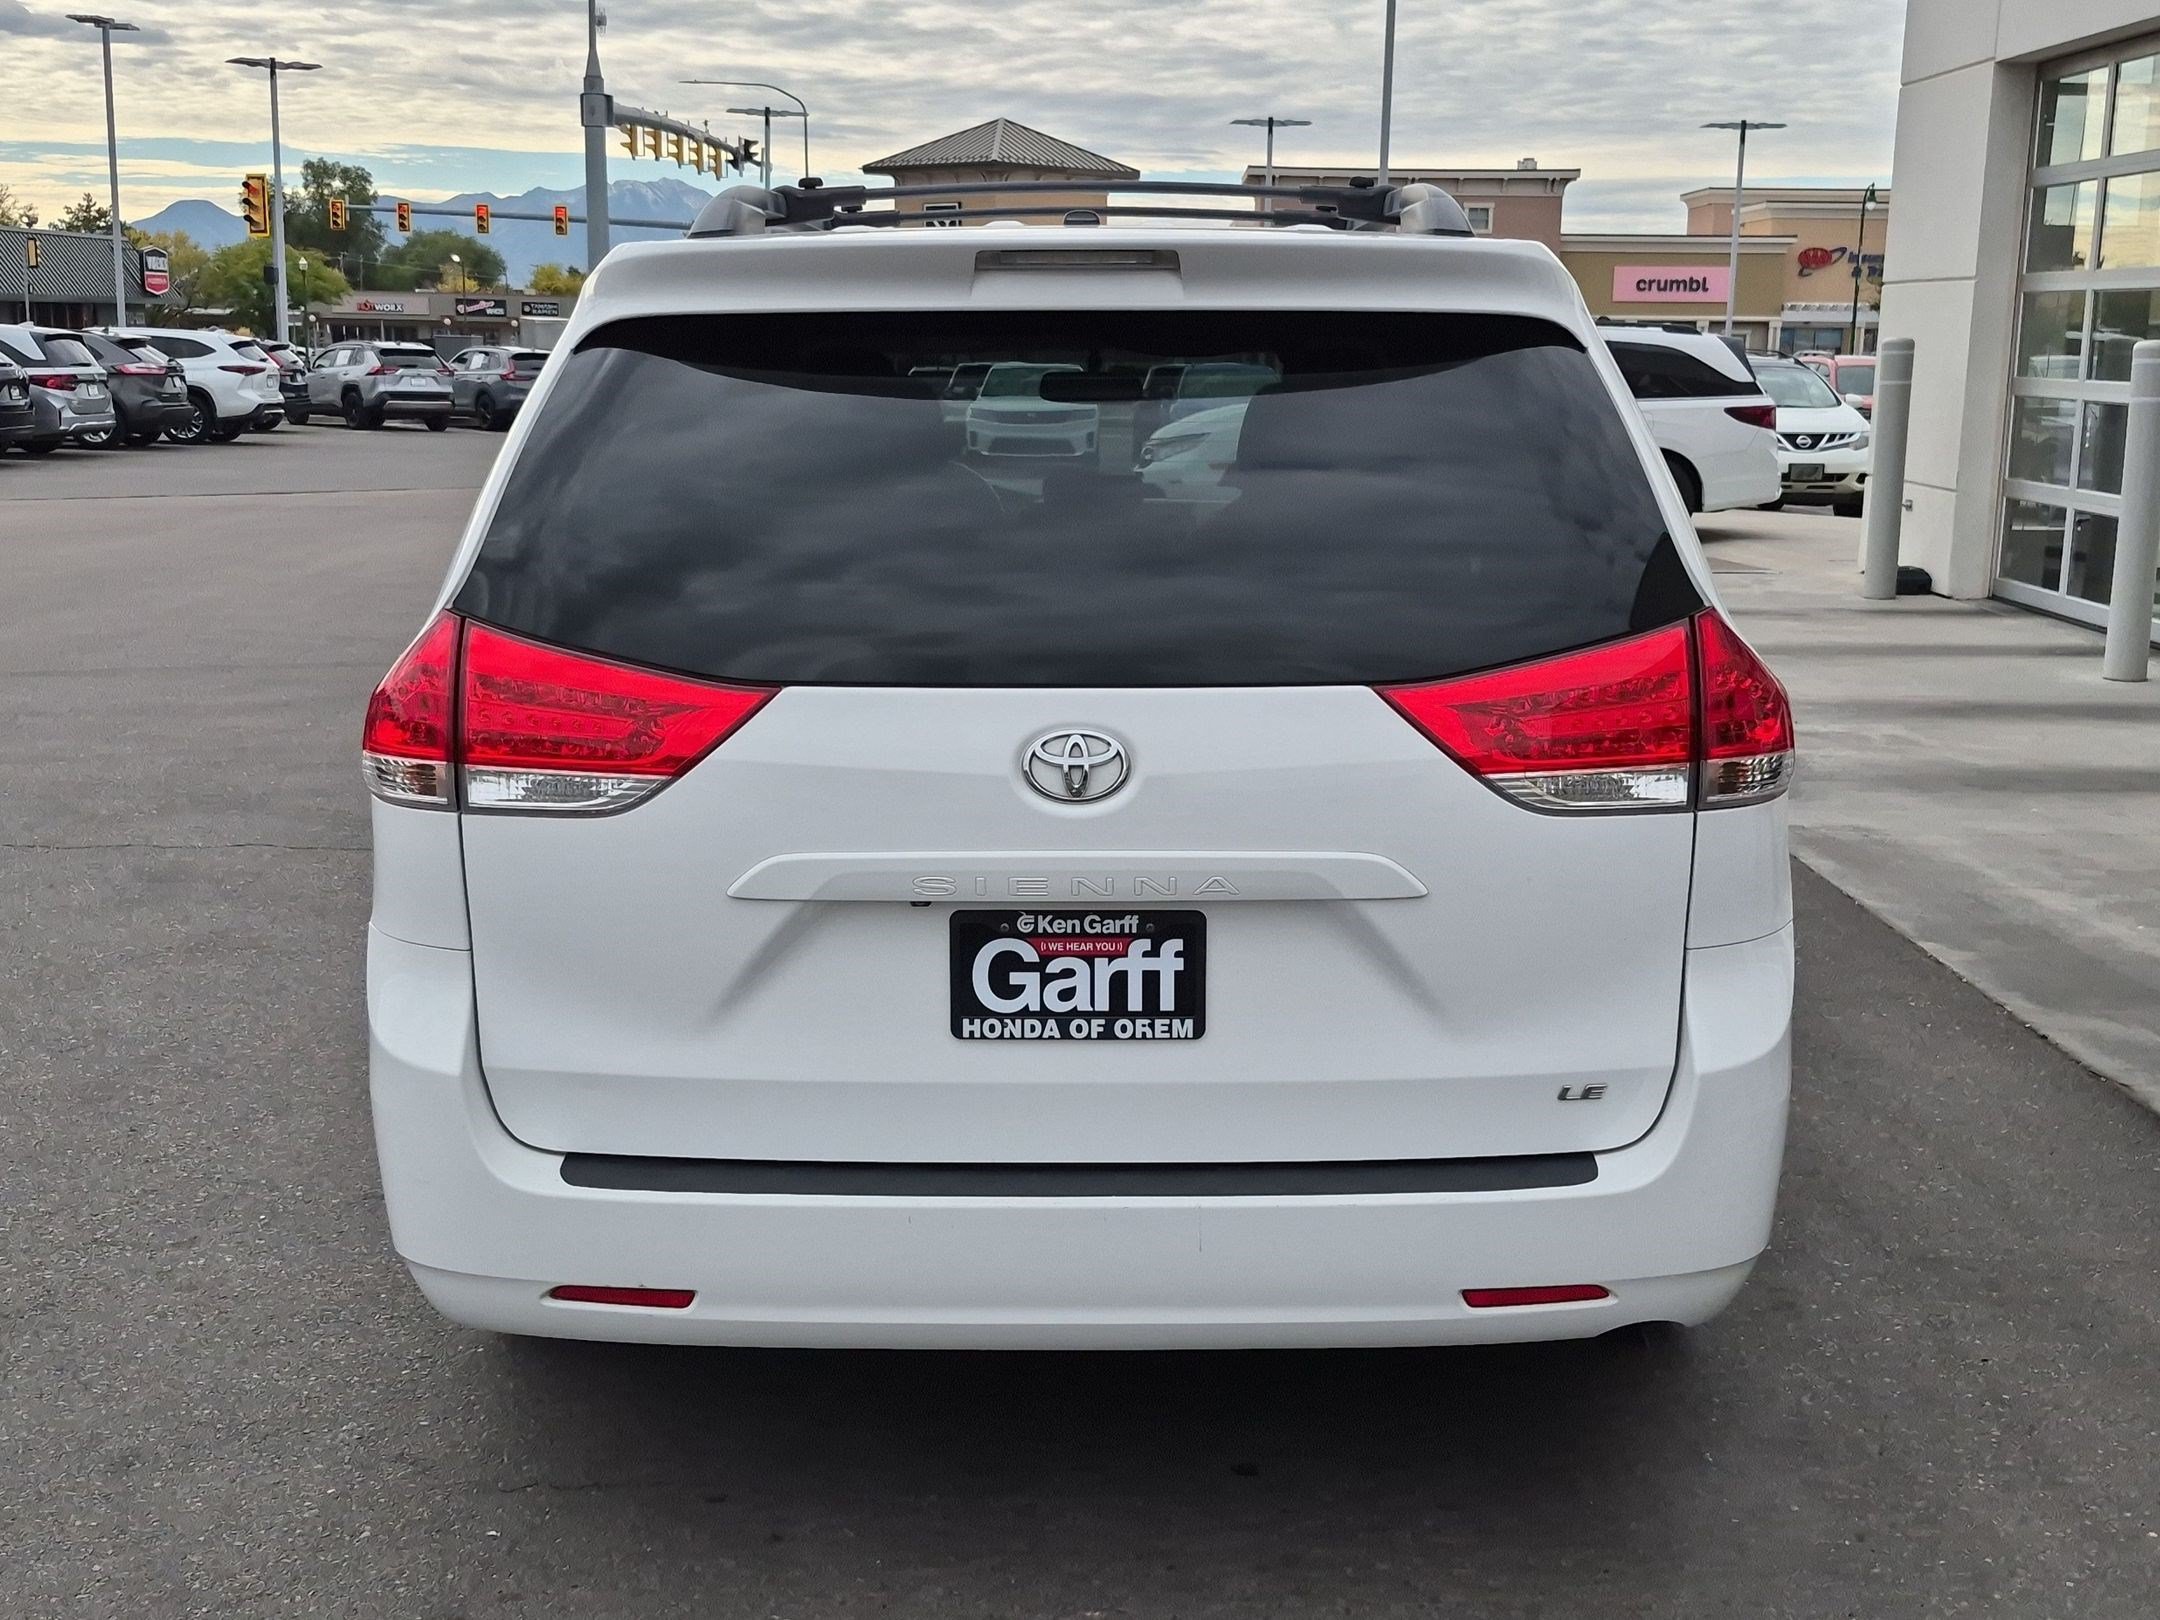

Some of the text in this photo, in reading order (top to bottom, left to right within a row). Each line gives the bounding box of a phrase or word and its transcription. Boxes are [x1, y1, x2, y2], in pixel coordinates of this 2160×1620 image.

[1636, 276, 1709, 292] crumbl
[912, 876, 1240, 896] SIENNA
[1037, 914, 1139, 934] Ken Garff
[1048, 942, 1116, 951] WE HEAR YOU
[972, 937, 1184, 1013] Garff
[962, 1018, 1194, 1039] HONDA OF OREM
[1557, 1083, 1608, 1101] LE
